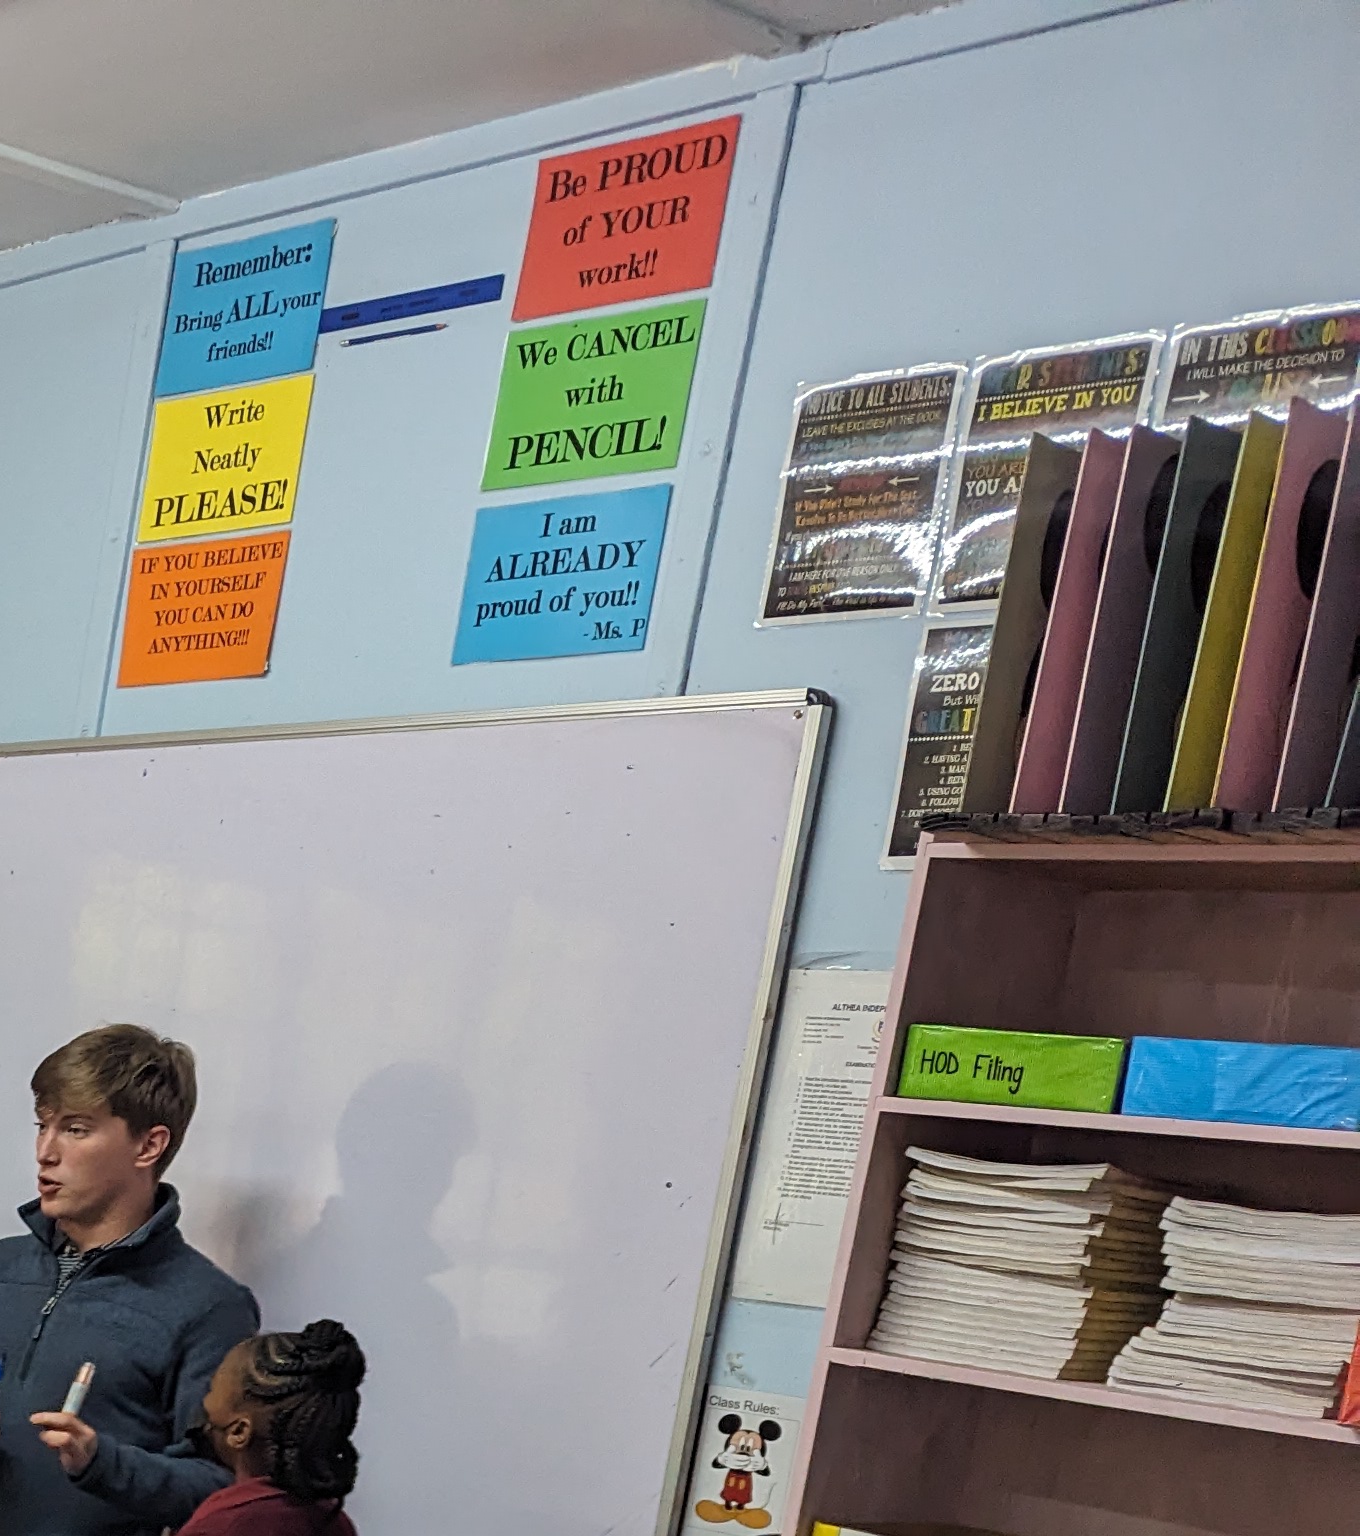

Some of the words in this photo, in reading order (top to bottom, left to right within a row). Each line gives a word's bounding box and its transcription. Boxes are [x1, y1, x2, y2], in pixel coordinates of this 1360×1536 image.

[546, 169, 586, 203] Be
[594, 133, 727, 192] PROUD
[562, 218, 590, 246] of
[598, 195, 690, 240] YOUR
[194, 243, 313, 287] Remember:
[577, 250, 656, 288] work!!
[174, 308, 223, 336] Bring
[226, 287, 278, 322] ALL
[280, 289, 322, 315] your
[206, 331, 274, 362] friends!!
[517, 339, 558, 368] We
[566, 315, 696, 361] CANCEL
[1179, 336, 1201, 365] IN
[1209, 331, 1248, 359] THIS
[564, 377, 624, 408] with
[978, 404, 987, 421] I
[990, 394, 1069, 419] BELIEVE
[1074, 391, 1094, 410] IN
[1099, 384, 1136, 406] YOU
[205, 399, 265, 426] Write
[190, 442, 261, 475] Neatly
[503, 416, 667, 470] PENCIL!
[151, 478, 288, 528] PLEASE!
[542, 513, 553, 537] I
[559, 514, 596, 536] am
[139, 557, 158, 575] IF
[162, 551, 200, 573] YOU
[203, 541, 283, 568] BELIEVE
[485, 538, 646, 582] ALREADY
[150, 581, 170, 599] IN
[174, 571, 266, 596] YOURSELF
[154, 606, 193, 626] YOU
[196, 603, 228, 623] CAN
[230, 600, 253, 619] DO
[475, 587, 543, 627] proud
[548, 584, 573, 614] of
[579, 581, 638, 616] you!!
[147, 627, 250, 654] ANYTHING!!!
[591, 620, 622, 642] Ms.
[629, 618, 645, 638] P
[930, 672, 979, 694] ZERO
[920, 1048, 959, 1076] HOD
[972, 1053, 1024, 1093] Filing
[709, 1395, 740, 1411] Class
[743, 1399, 779, 1416] Rules:
